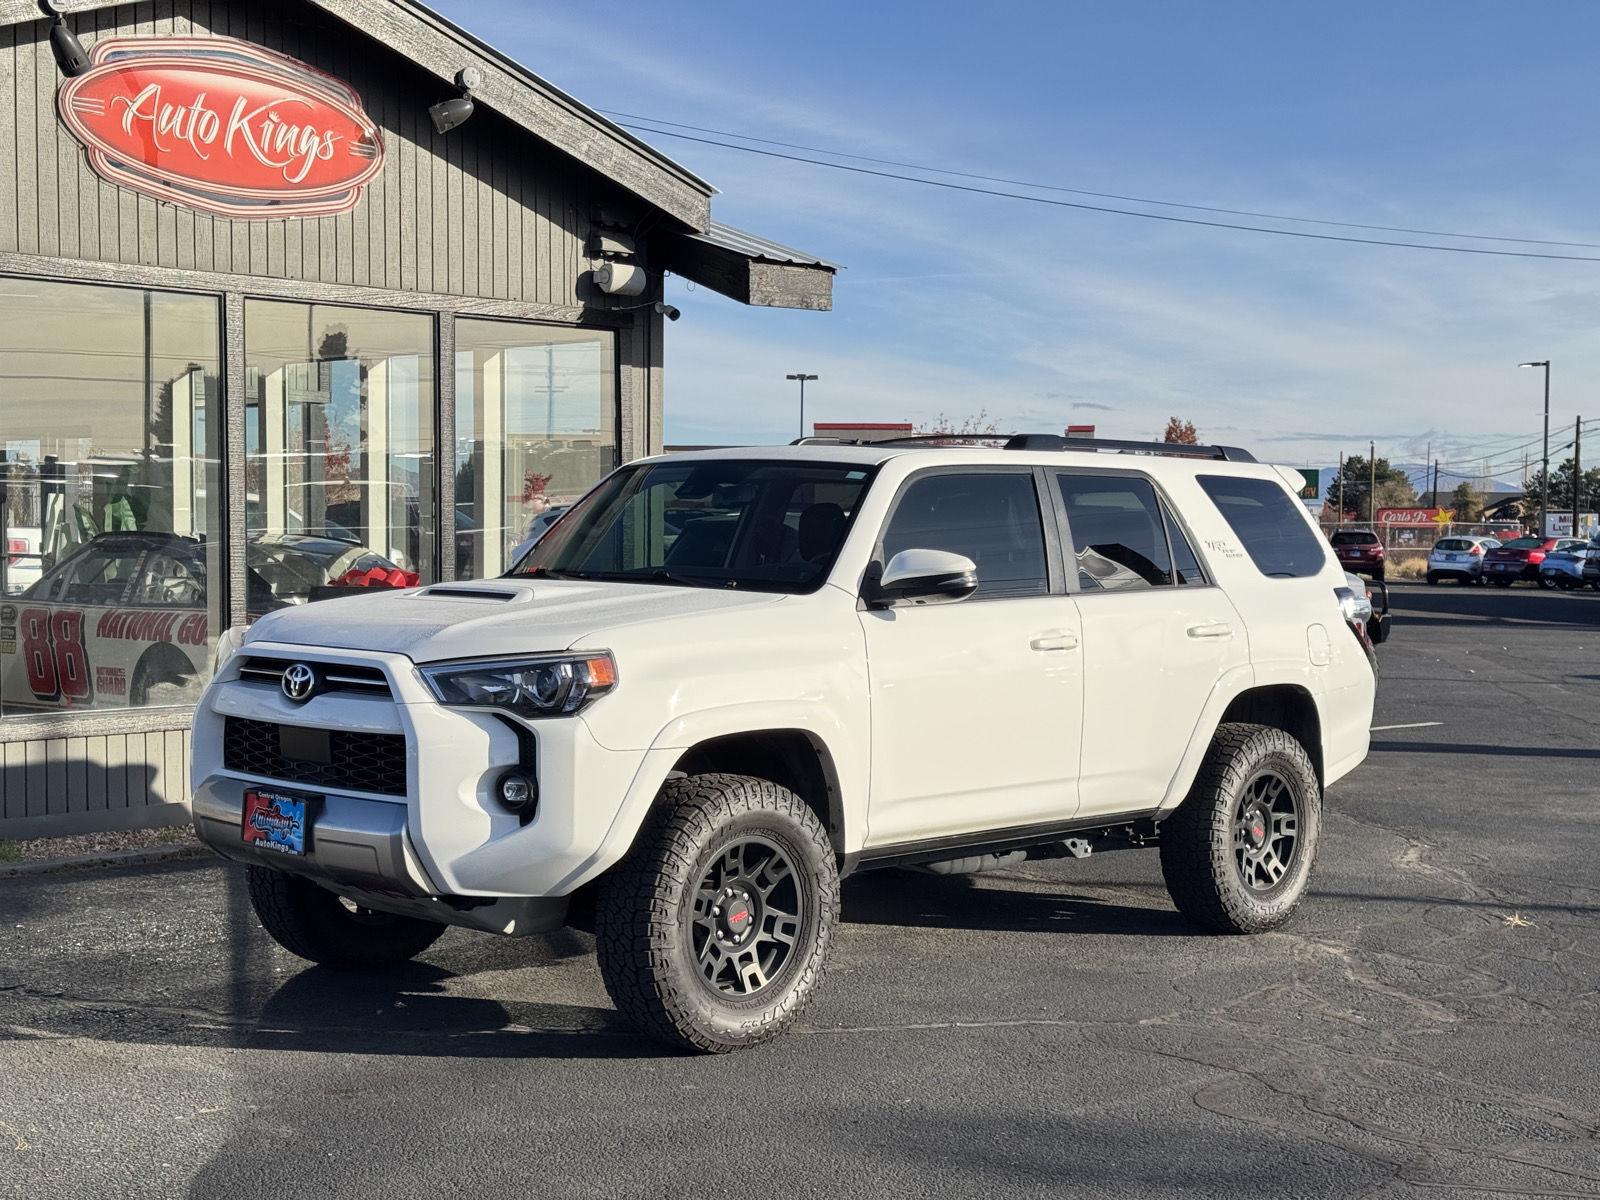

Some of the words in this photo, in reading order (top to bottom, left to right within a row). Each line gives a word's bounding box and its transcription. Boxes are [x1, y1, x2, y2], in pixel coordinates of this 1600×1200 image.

[110, 83, 220, 160] Auto
[224, 95, 343, 184] Kings
[1382, 511, 1411, 522] Carl's
[20, 607, 91, 700] 88
[96, 609, 181, 643] NATIONAL
